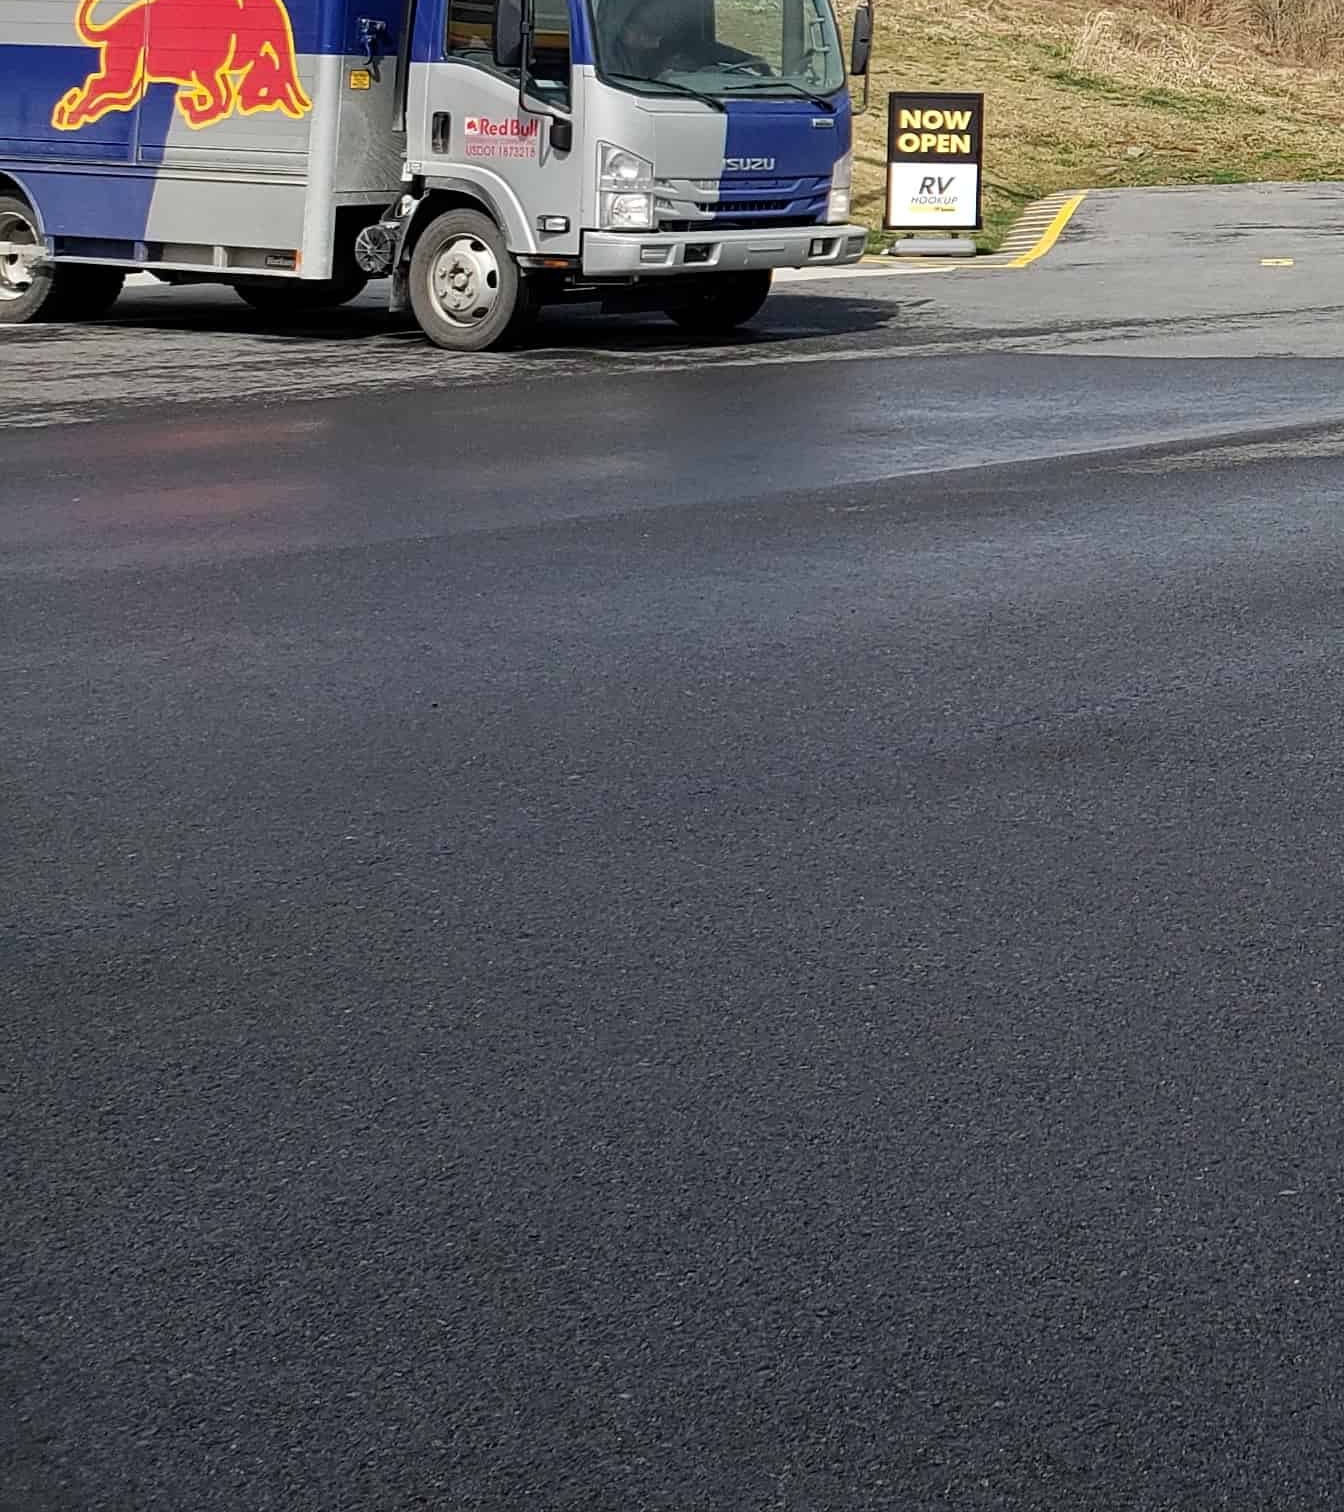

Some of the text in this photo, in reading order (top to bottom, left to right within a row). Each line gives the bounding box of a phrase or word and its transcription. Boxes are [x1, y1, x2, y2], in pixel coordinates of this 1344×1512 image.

[480, 118, 538, 137] Red Bull
[899, 109, 972, 130] NOW
[465, 144, 495, 156] USDOT
[897, 132, 971, 154] OPEN
[919, 176, 955, 195] RV
[911, 196, 958, 205] HOOKUP
